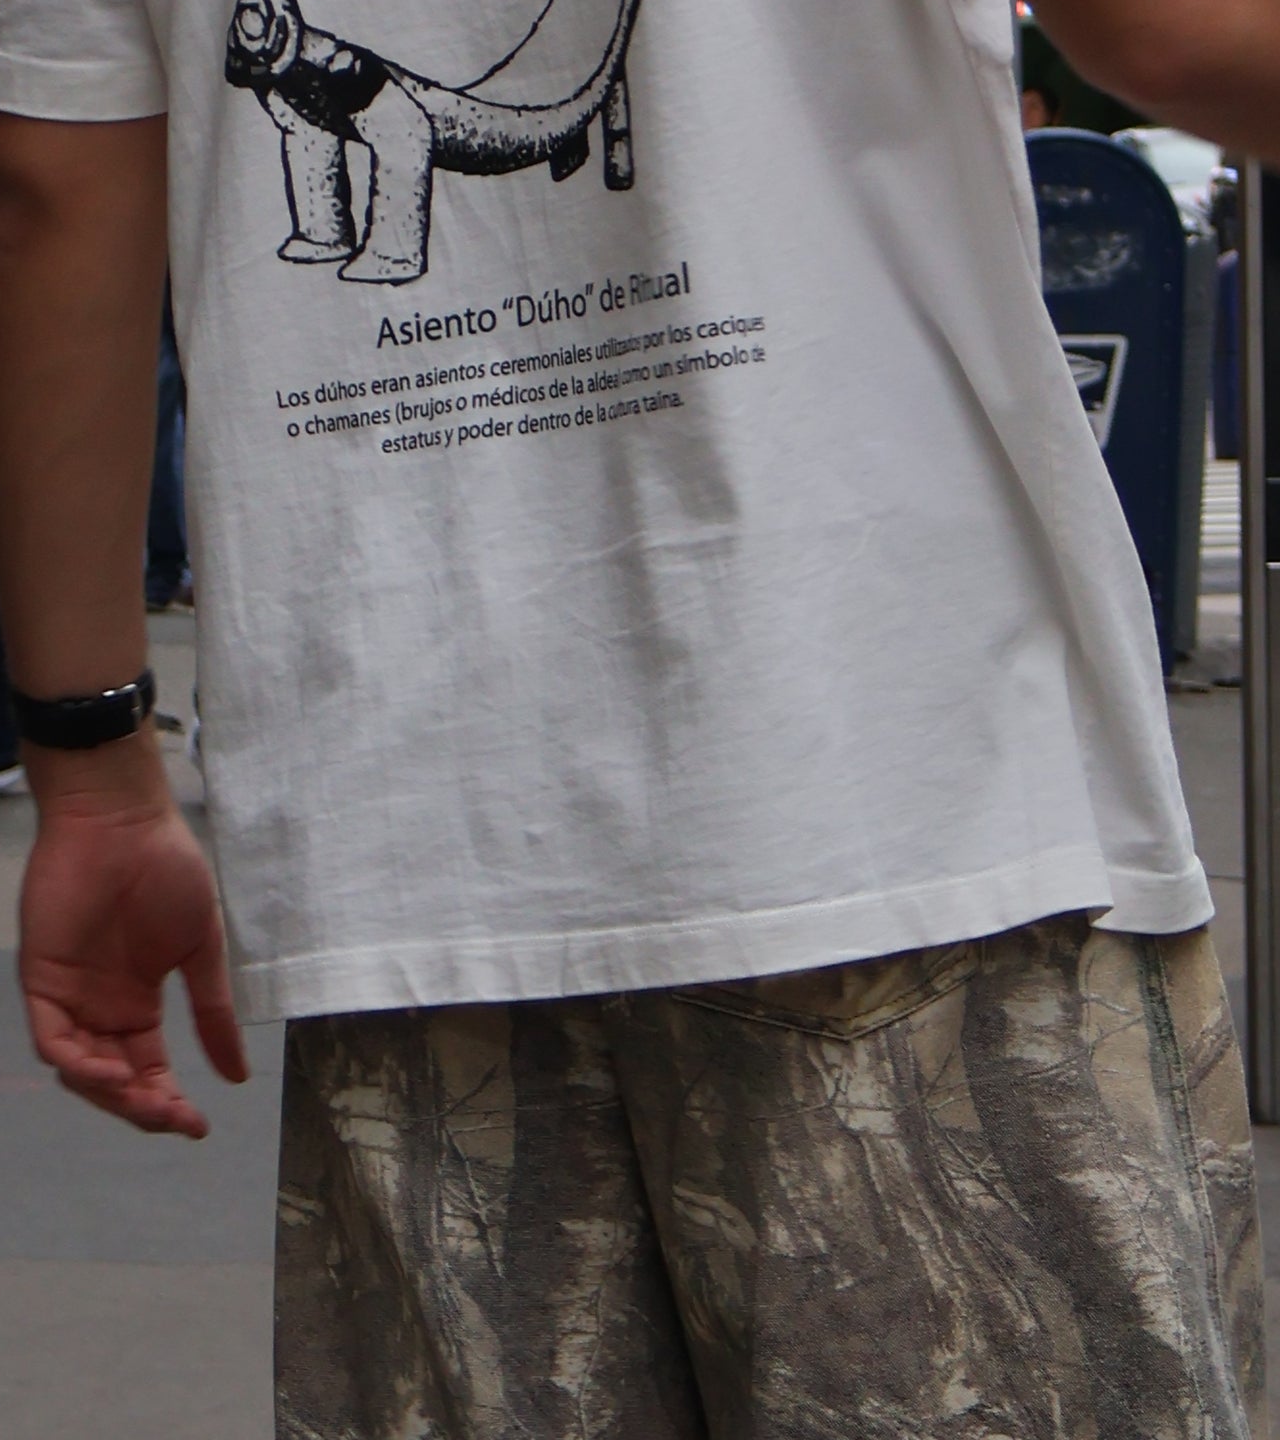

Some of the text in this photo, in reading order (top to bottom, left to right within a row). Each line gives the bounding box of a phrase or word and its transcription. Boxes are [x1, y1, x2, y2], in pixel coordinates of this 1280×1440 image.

[376, 307, 497, 350] Asiento
[600, 277, 626, 313] de
[276, 389, 311, 409] Los
[315, 381, 367, 404] dúhos
[371, 374, 411, 395] eran
[415, 363, 485, 389] asientos
[490, 344, 592, 377] ceremoniales
[642, 329, 665, 353] por
[669, 323, 693, 345] los
[287, 423, 300, 437] o
[304, 407, 391, 435] chamanes
[395, 397, 453, 425] (brujos
[455, 395, 467, 411] o
[472, 383, 546, 410] médicos
[548, 379, 568, 400] de
[572, 375, 584, 395] la
[652, 361, 674, 379] un
[676, 344, 750, 376] símbolo
[381, 428, 442, 455] estatus
[444, 428, 455, 449] y
[458, 419, 513, 449] poder
[517, 411, 570, 435] dentro
[574, 405, 594, 426] de
[596, 402, 608, 422] la
